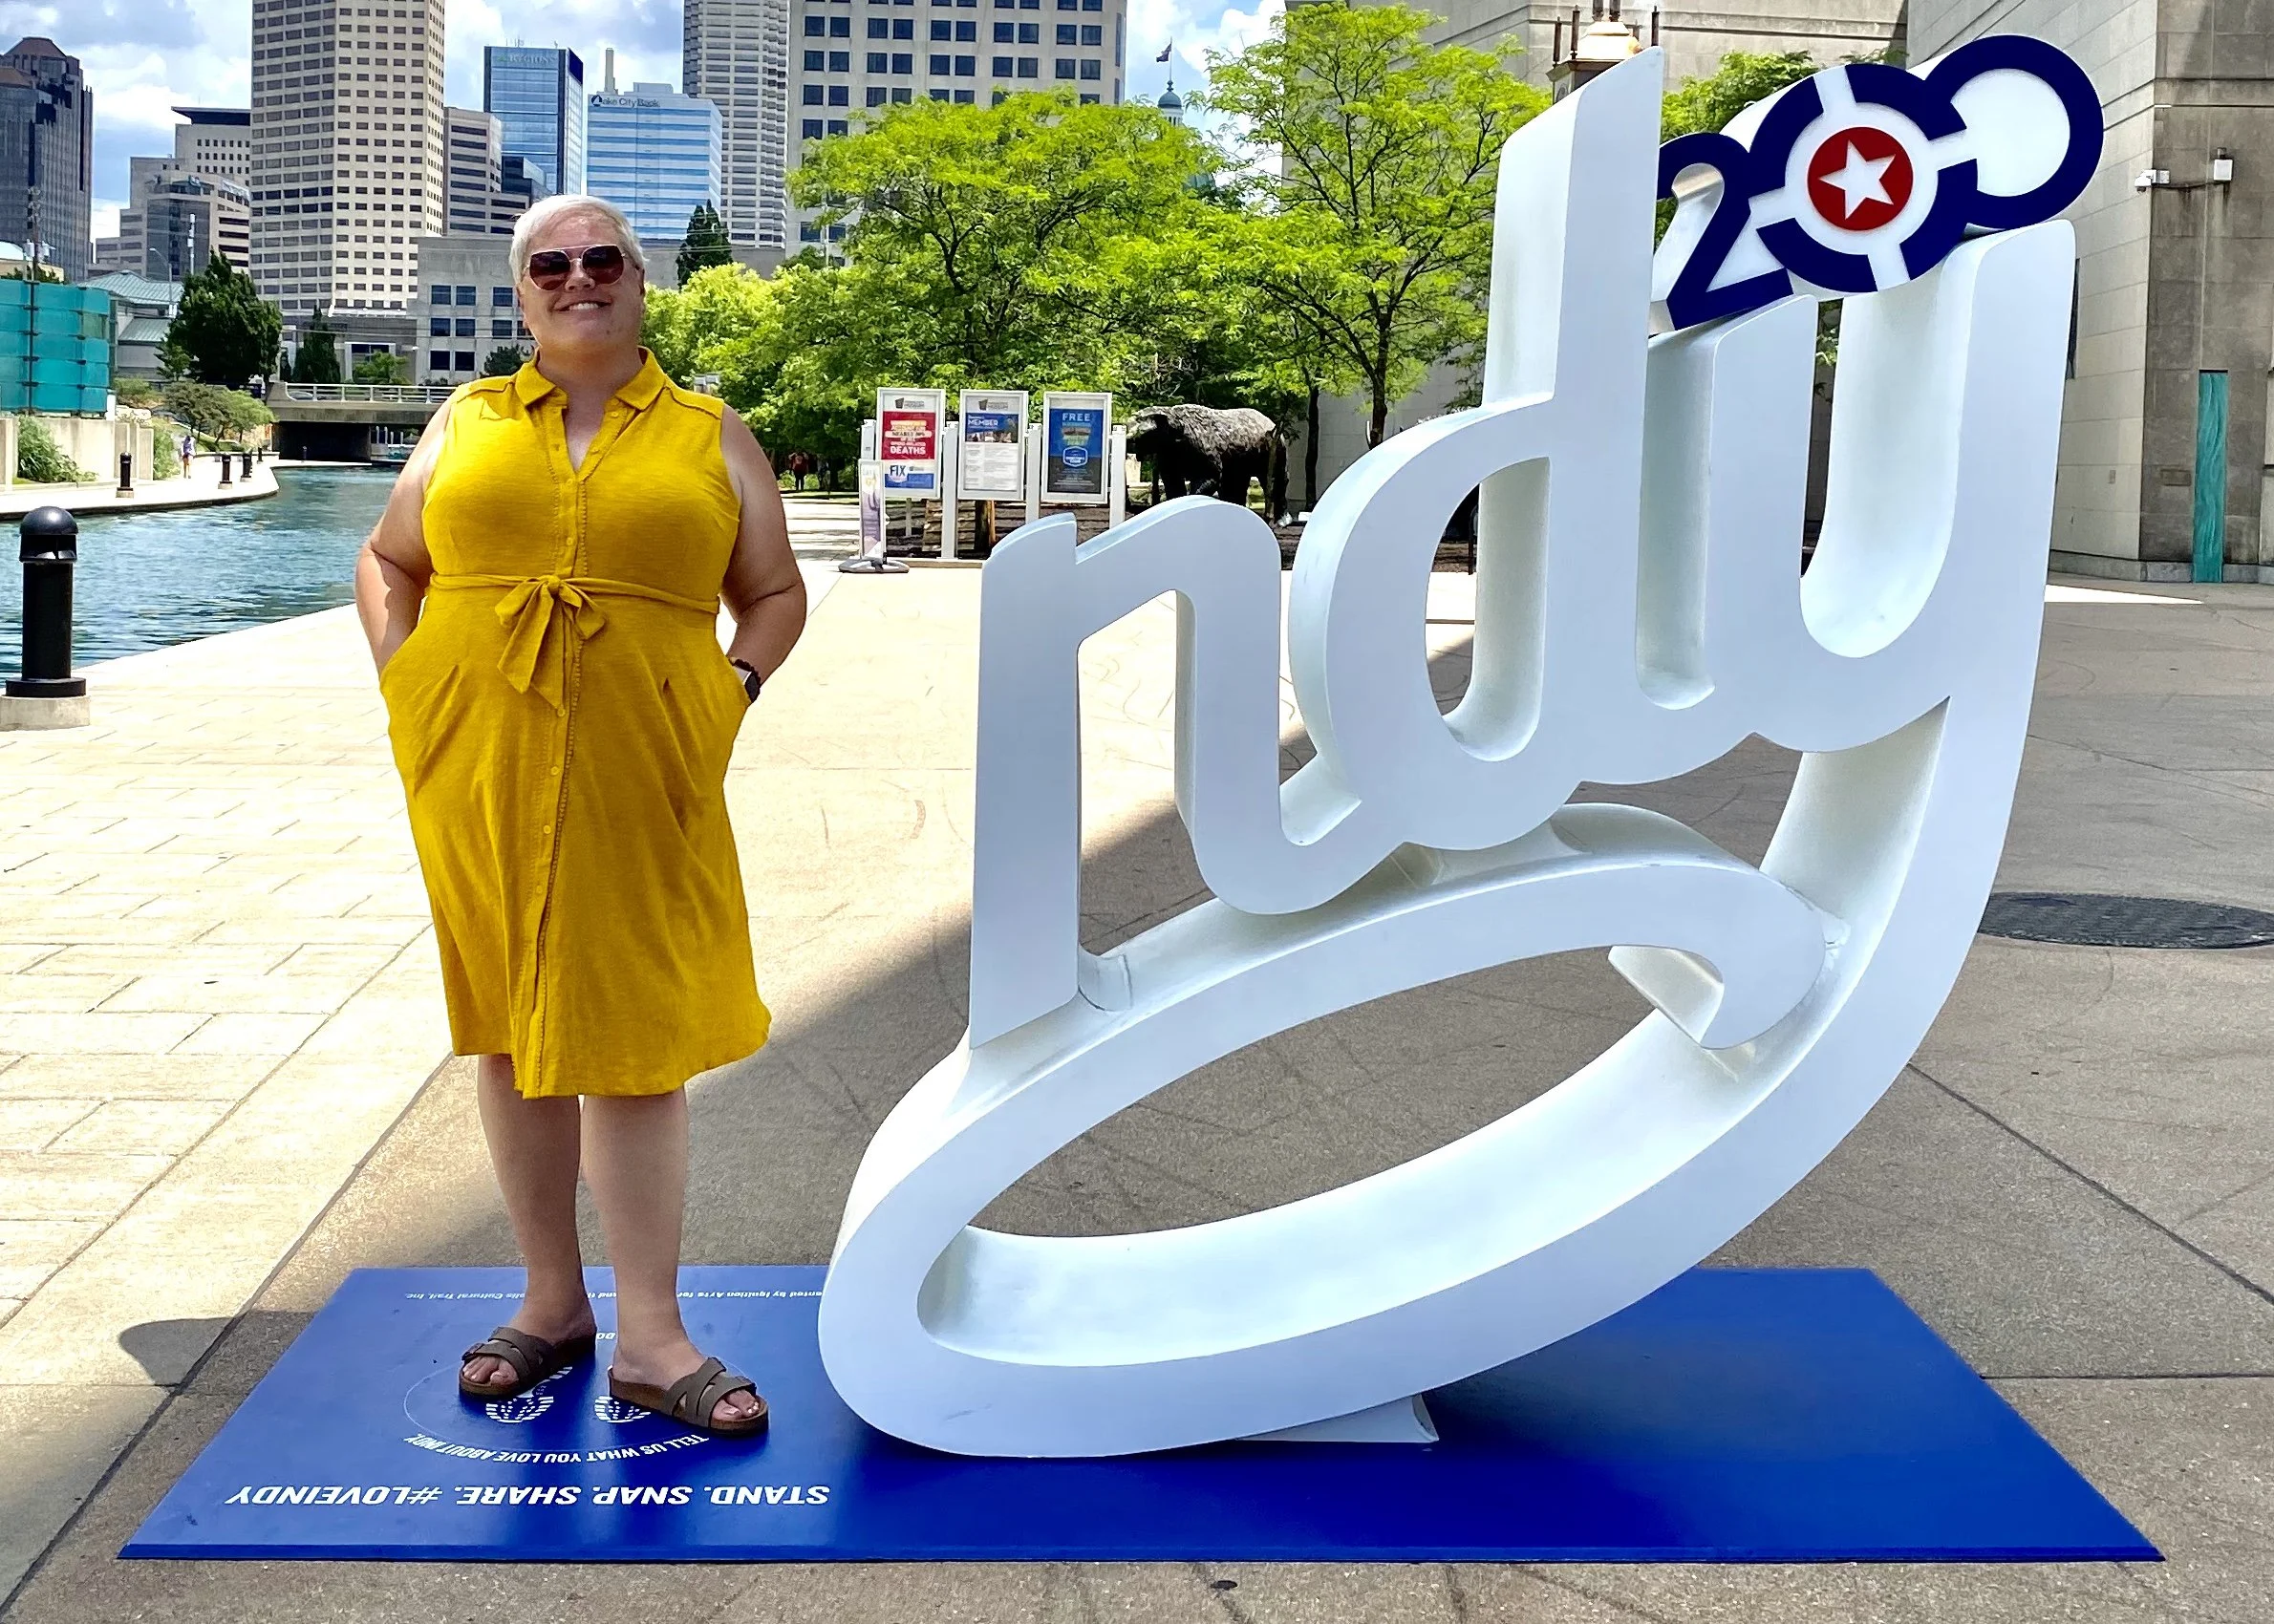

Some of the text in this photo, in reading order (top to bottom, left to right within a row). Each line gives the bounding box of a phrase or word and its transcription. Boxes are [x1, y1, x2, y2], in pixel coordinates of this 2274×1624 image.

[619, 97, 636, 108] City
[1062, 413, 1090, 421] FREE
[890, 446, 926, 455] DEATHS
[890, 465, 906, 477] FIX
[726, 1290, 771, 1298] Ignition
[773, 1290, 786, 1298] by
[665, 1433, 709, 1449] TELL
[436, 1443, 497, 1460] ABOUT
[587, 1447, 640, 1462] WHAT
[639, 1442, 665, 1455] US
[493, 1451, 541, 1464] LOVE
[544, 1452, 582, 1464] YOU
[225, 1485, 830, 1506] STAND. SNAP. SHARE. #LOVEINDY
